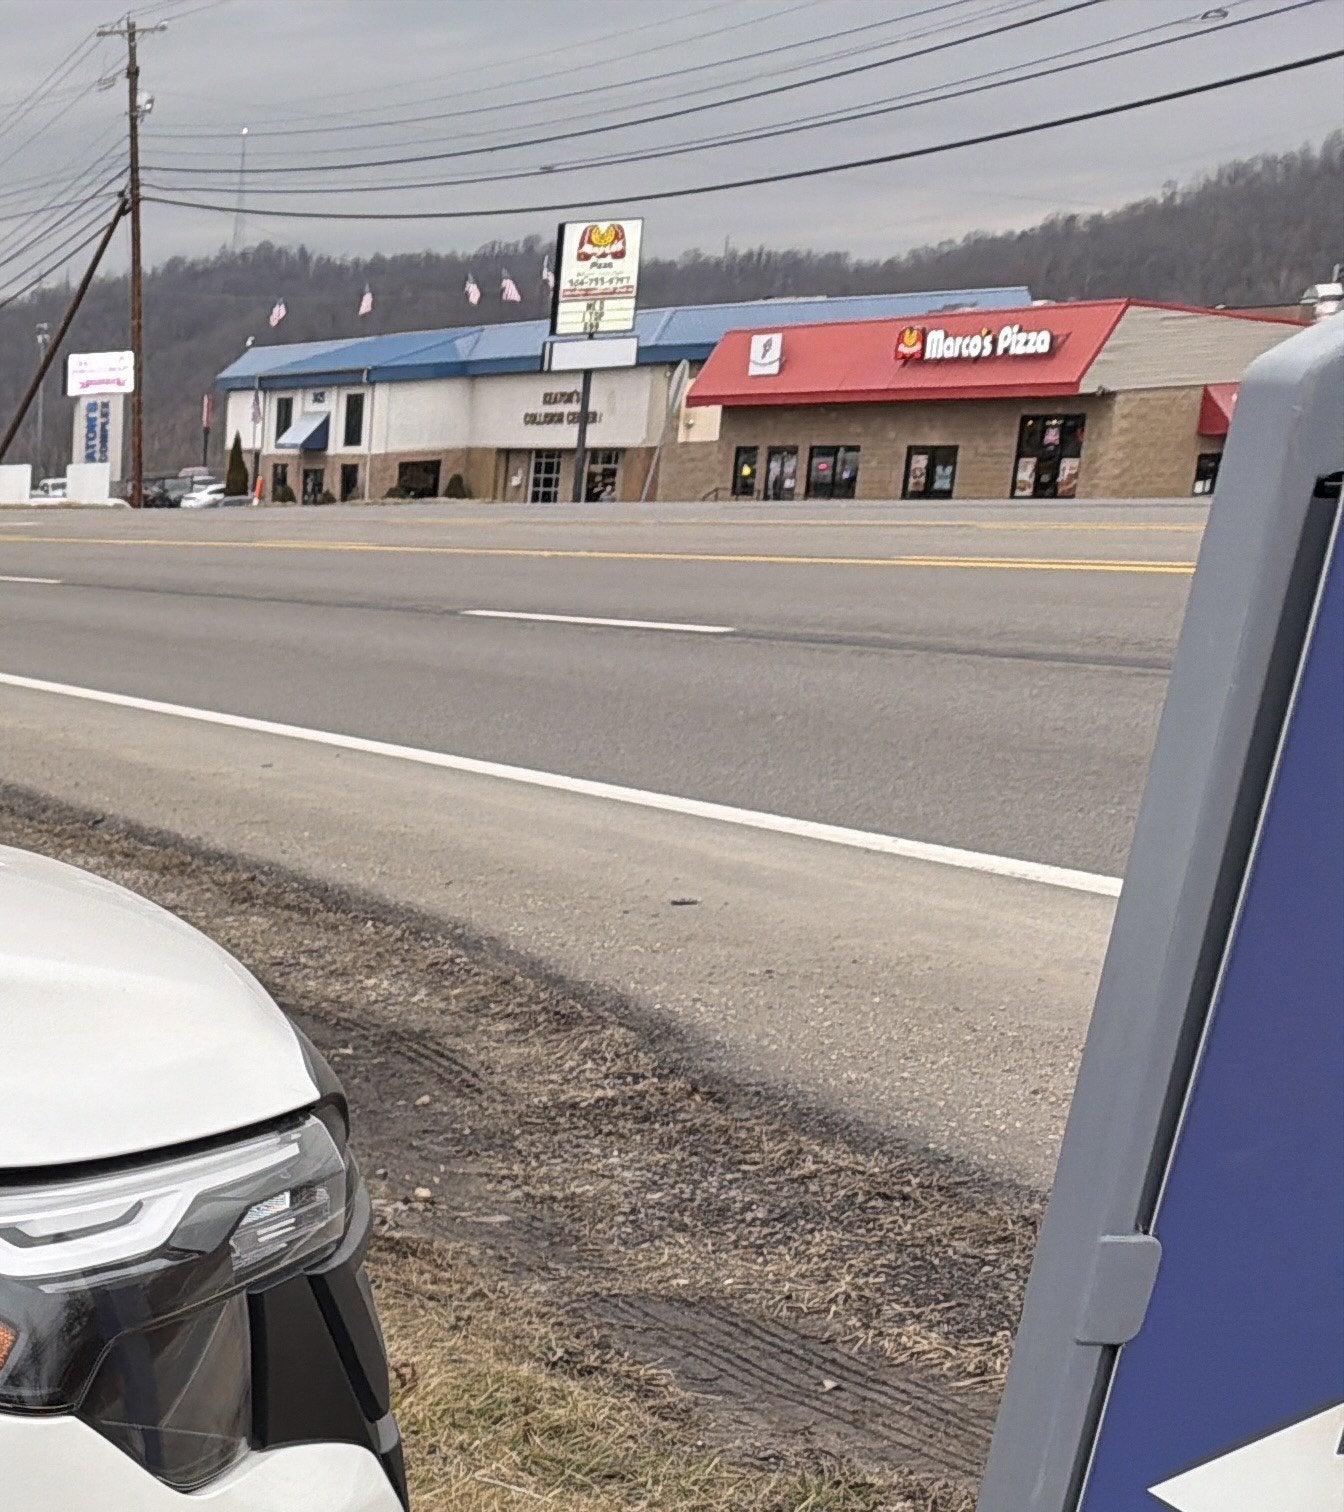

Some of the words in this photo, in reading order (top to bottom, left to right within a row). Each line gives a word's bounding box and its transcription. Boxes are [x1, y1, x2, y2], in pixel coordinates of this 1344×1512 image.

[924, 327, 993, 360] Marco's
[997, 323, 1051, 356] Pizza
[567, 411, 598, 425] CENER
